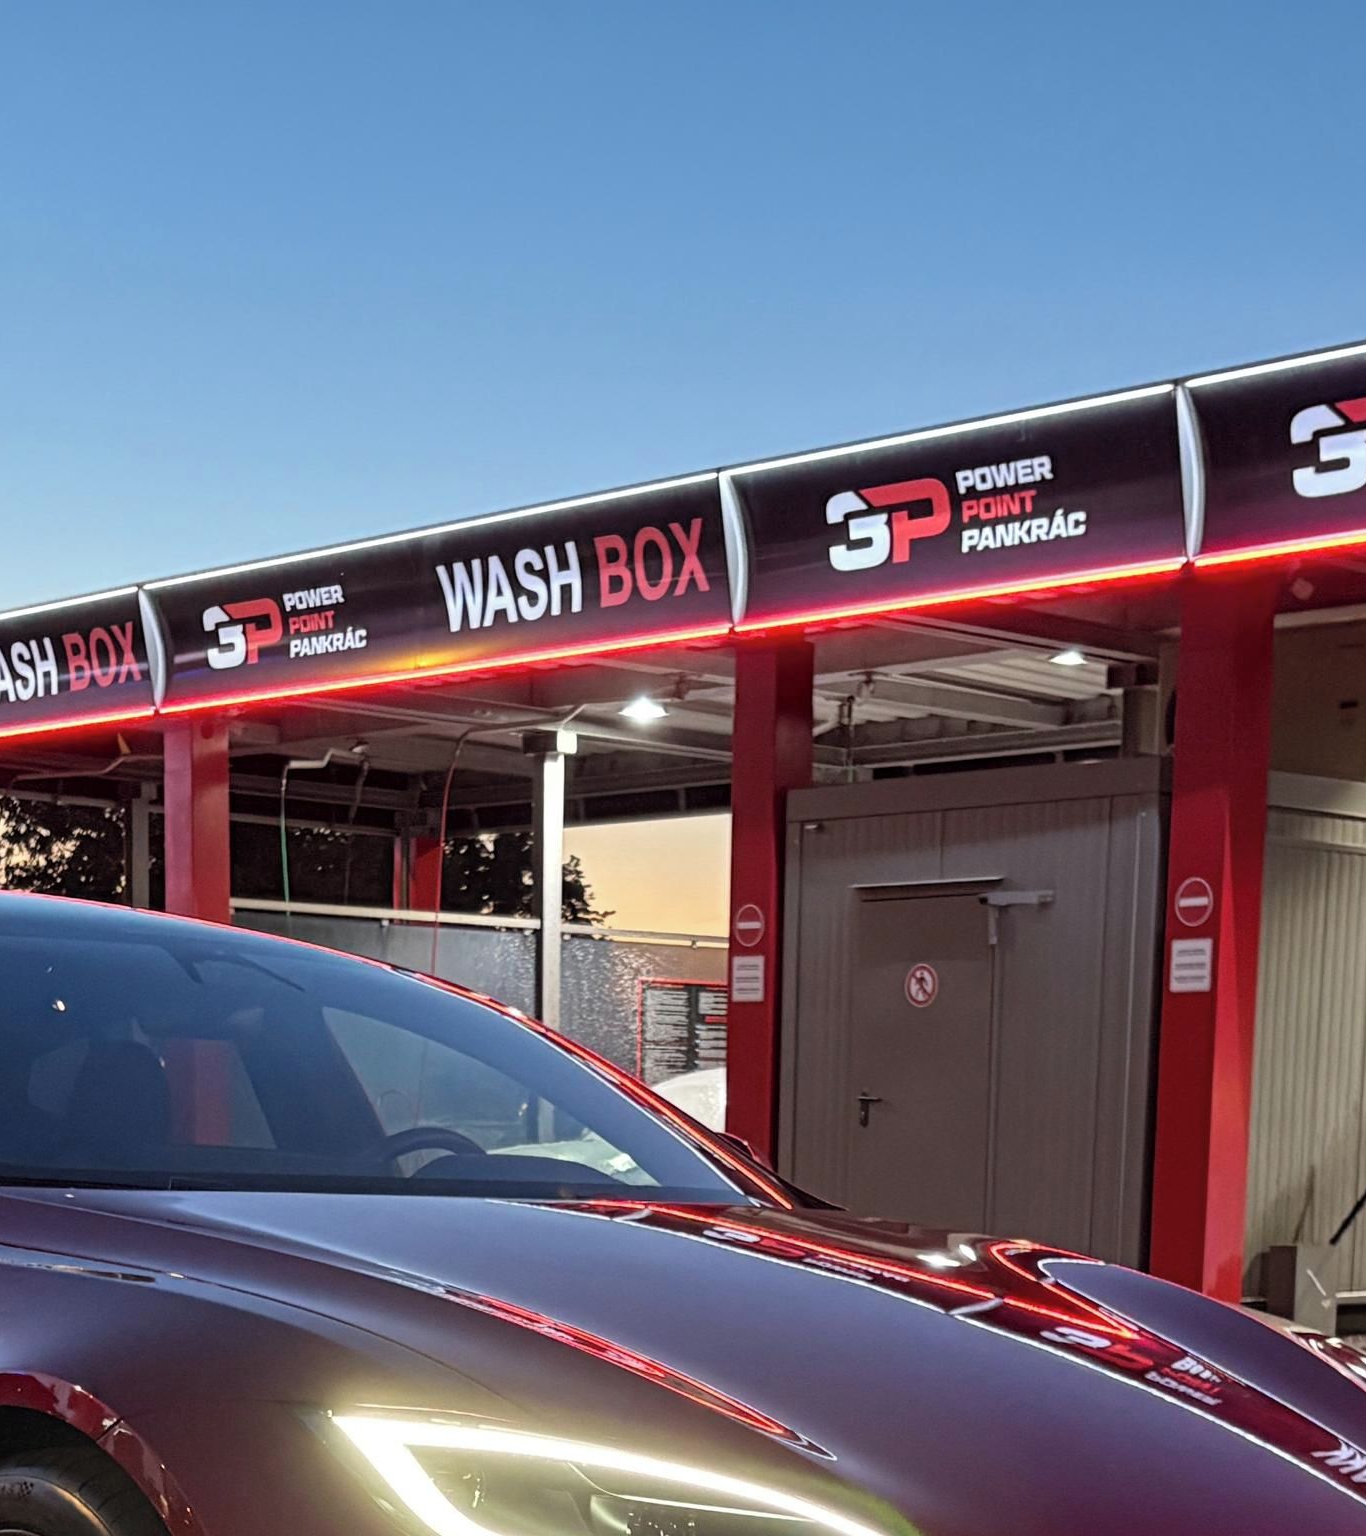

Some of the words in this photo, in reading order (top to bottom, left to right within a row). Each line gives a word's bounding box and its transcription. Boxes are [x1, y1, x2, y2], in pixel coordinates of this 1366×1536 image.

[956, 456, 1053, 495] POWER
[826, 479, 951, 571] 3P
[960, 490, 1040, 521] POINT
[962, 506, 1086, 553] PANKRÁC
[436, 542, 585, 634] WASH
[595, 519, 710, 608] BOX
[283, 585, 344, 612] POWER
[201, 597, 284, 669] 3P
[288, 609, 336, 634] POINT
[290, 625, 366, 658] PANKRÁC
[63, 621, 143, 692] BOX
